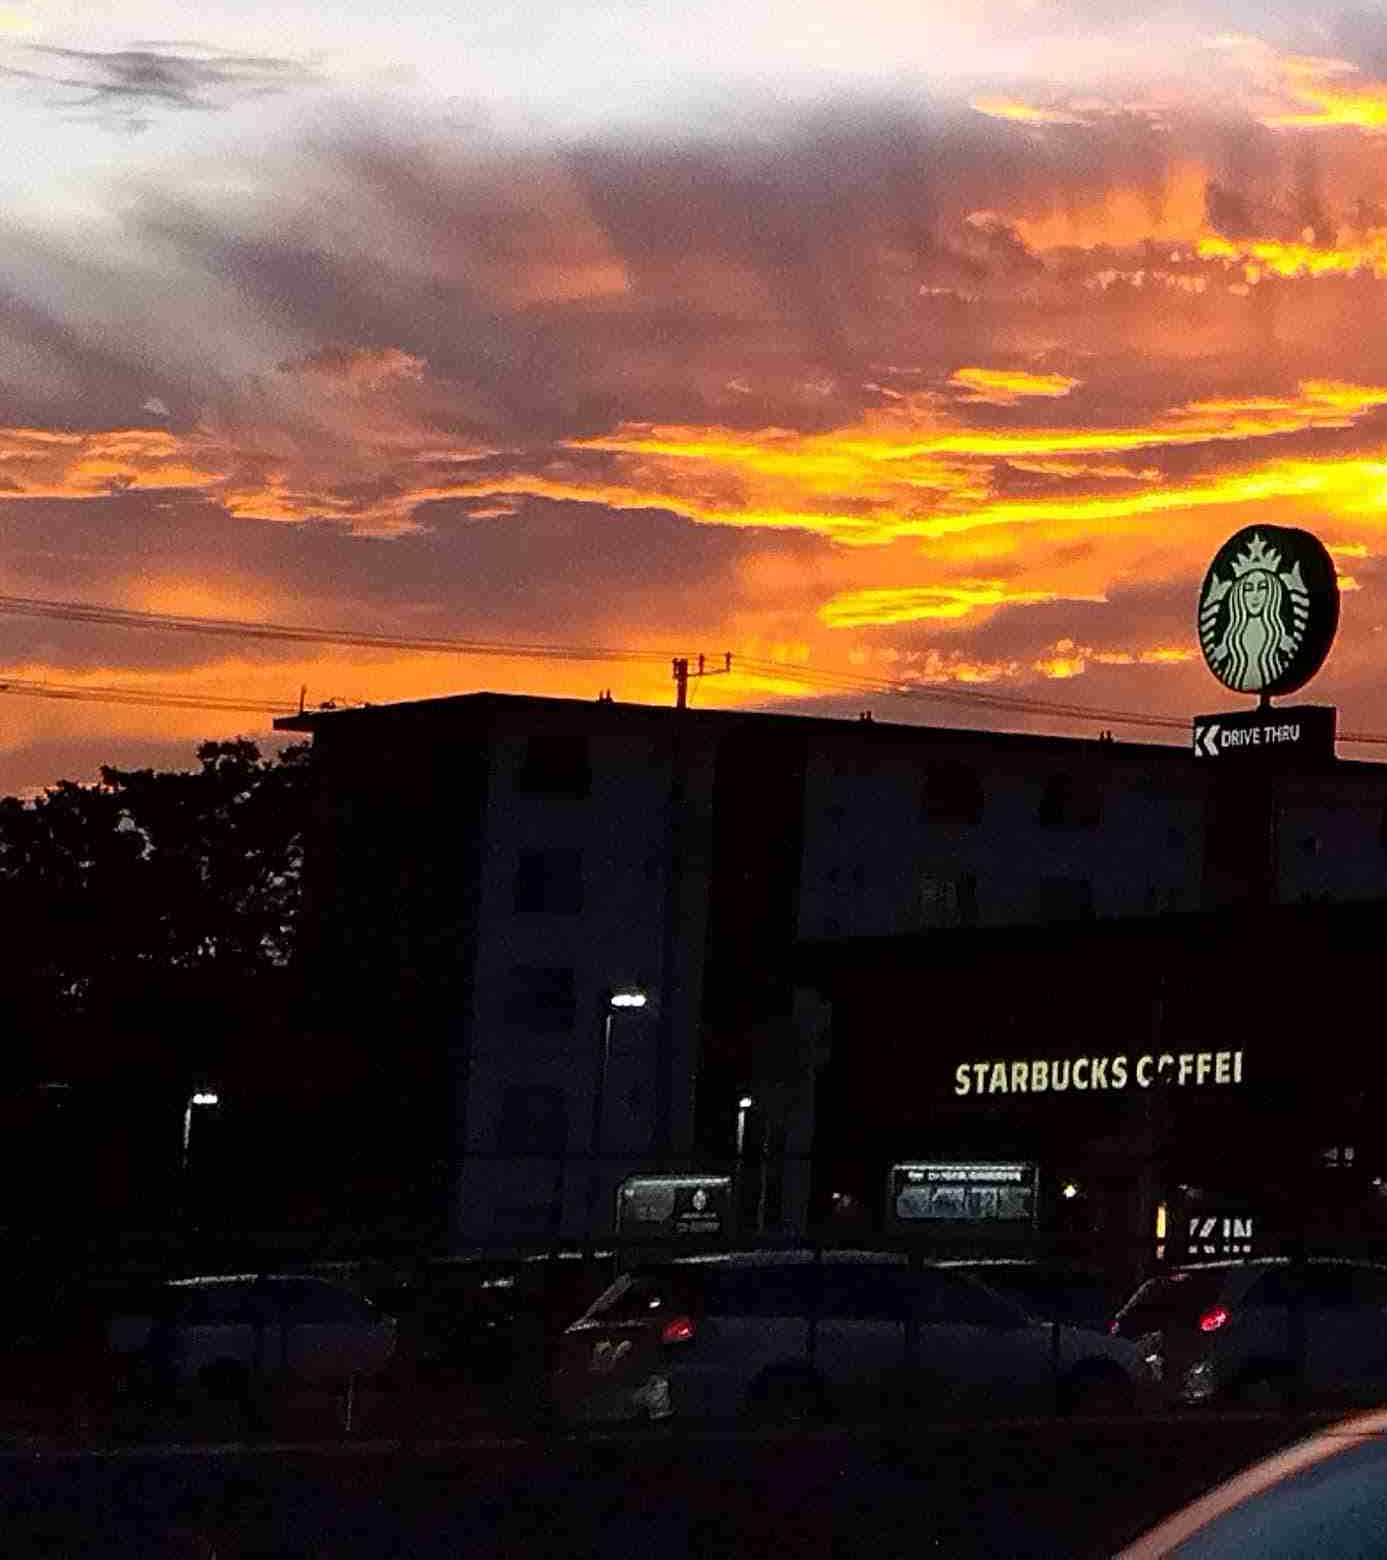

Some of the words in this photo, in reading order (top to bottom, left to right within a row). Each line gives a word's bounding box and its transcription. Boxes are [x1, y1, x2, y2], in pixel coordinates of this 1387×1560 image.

[1221, 728, 1261, 747] DRIVE
[1263, 725, 1300, 744] THRU
[954, 1055, 1128, 1096] STARBUCKS
